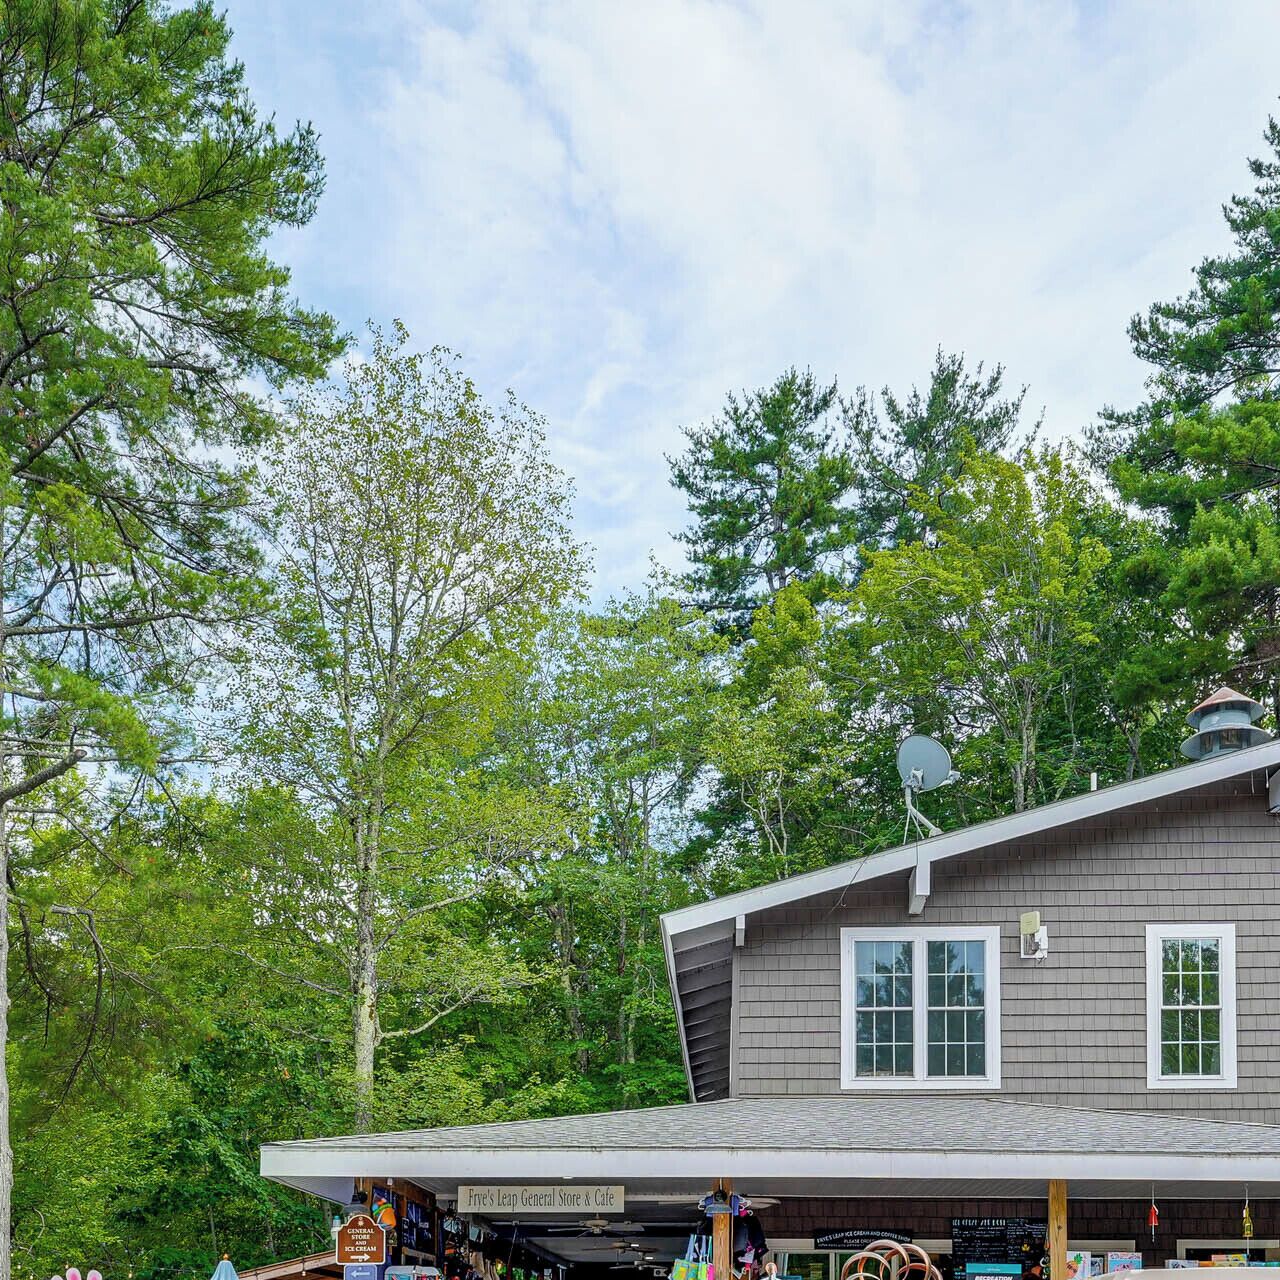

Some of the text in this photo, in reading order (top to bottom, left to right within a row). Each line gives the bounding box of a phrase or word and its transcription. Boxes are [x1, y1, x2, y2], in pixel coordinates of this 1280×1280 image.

[468, 1186, 615, 1212] Frye's Leap General Store & Cafe
[832, 1232, 844, 1240] LEAP
[881, 1231, 898, 1239] COFFEE
[898, 1234, 911, 1242] SHOP
